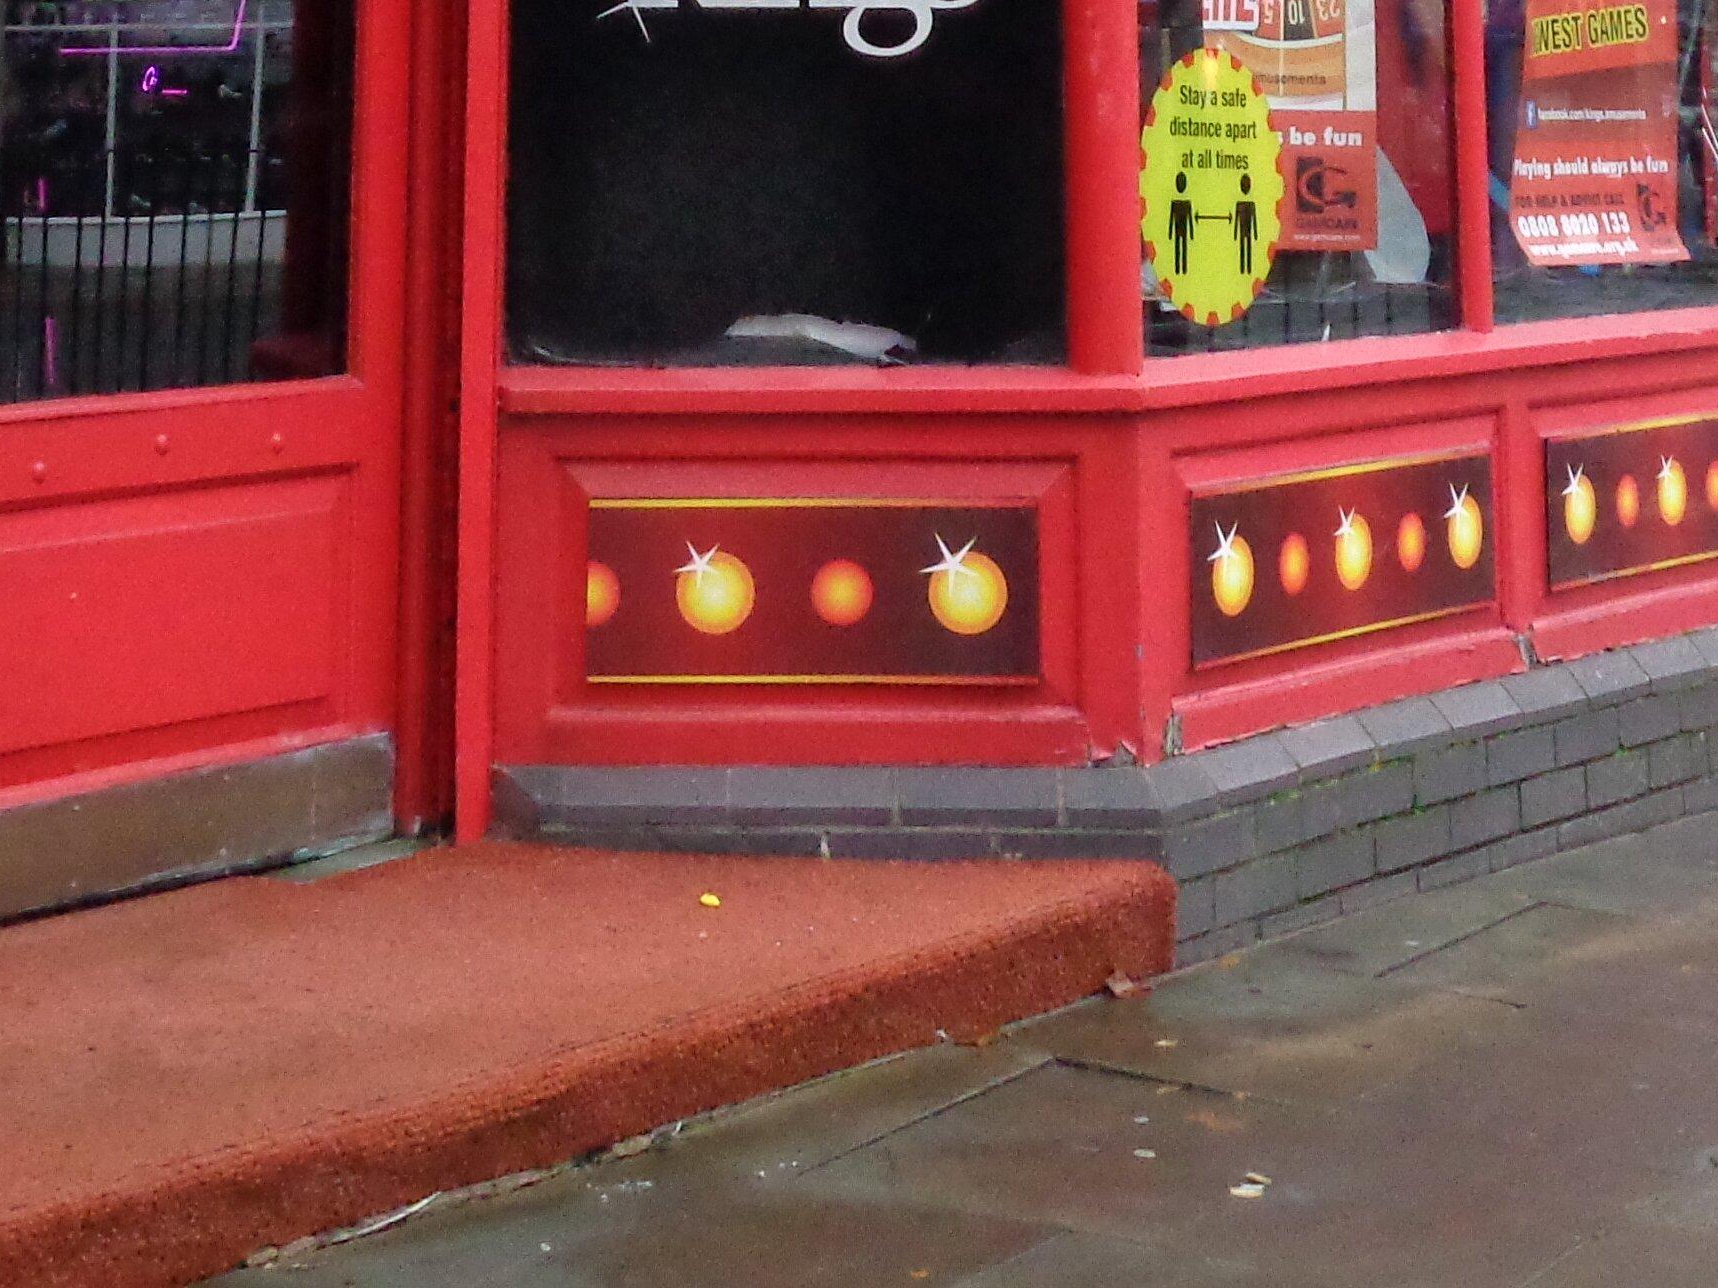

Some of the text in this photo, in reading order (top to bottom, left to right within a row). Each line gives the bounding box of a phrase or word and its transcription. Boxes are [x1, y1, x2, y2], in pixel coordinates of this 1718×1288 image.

[1587, 6, 1647, 45] GAMES
[1179, 84, 1207, 109] Stay
[1221, 88, 1247, 108] safe
[1169, 116, 1222, 138] distance
[1225, 121, 1257, 143] apart
[1289, 126, 1317, 146] be
[1323, 126, 1363, 146] fun
[1181, 149, 1249, 170] at all times
[1553, 155, 1589, 175] should
[1591, 156, 1628, 179] always
[1630, 155, 1644, 174] be
[1646, 155, 1669, 173] fun
[1517, 211, 1631, 238] 0808 8020 133
